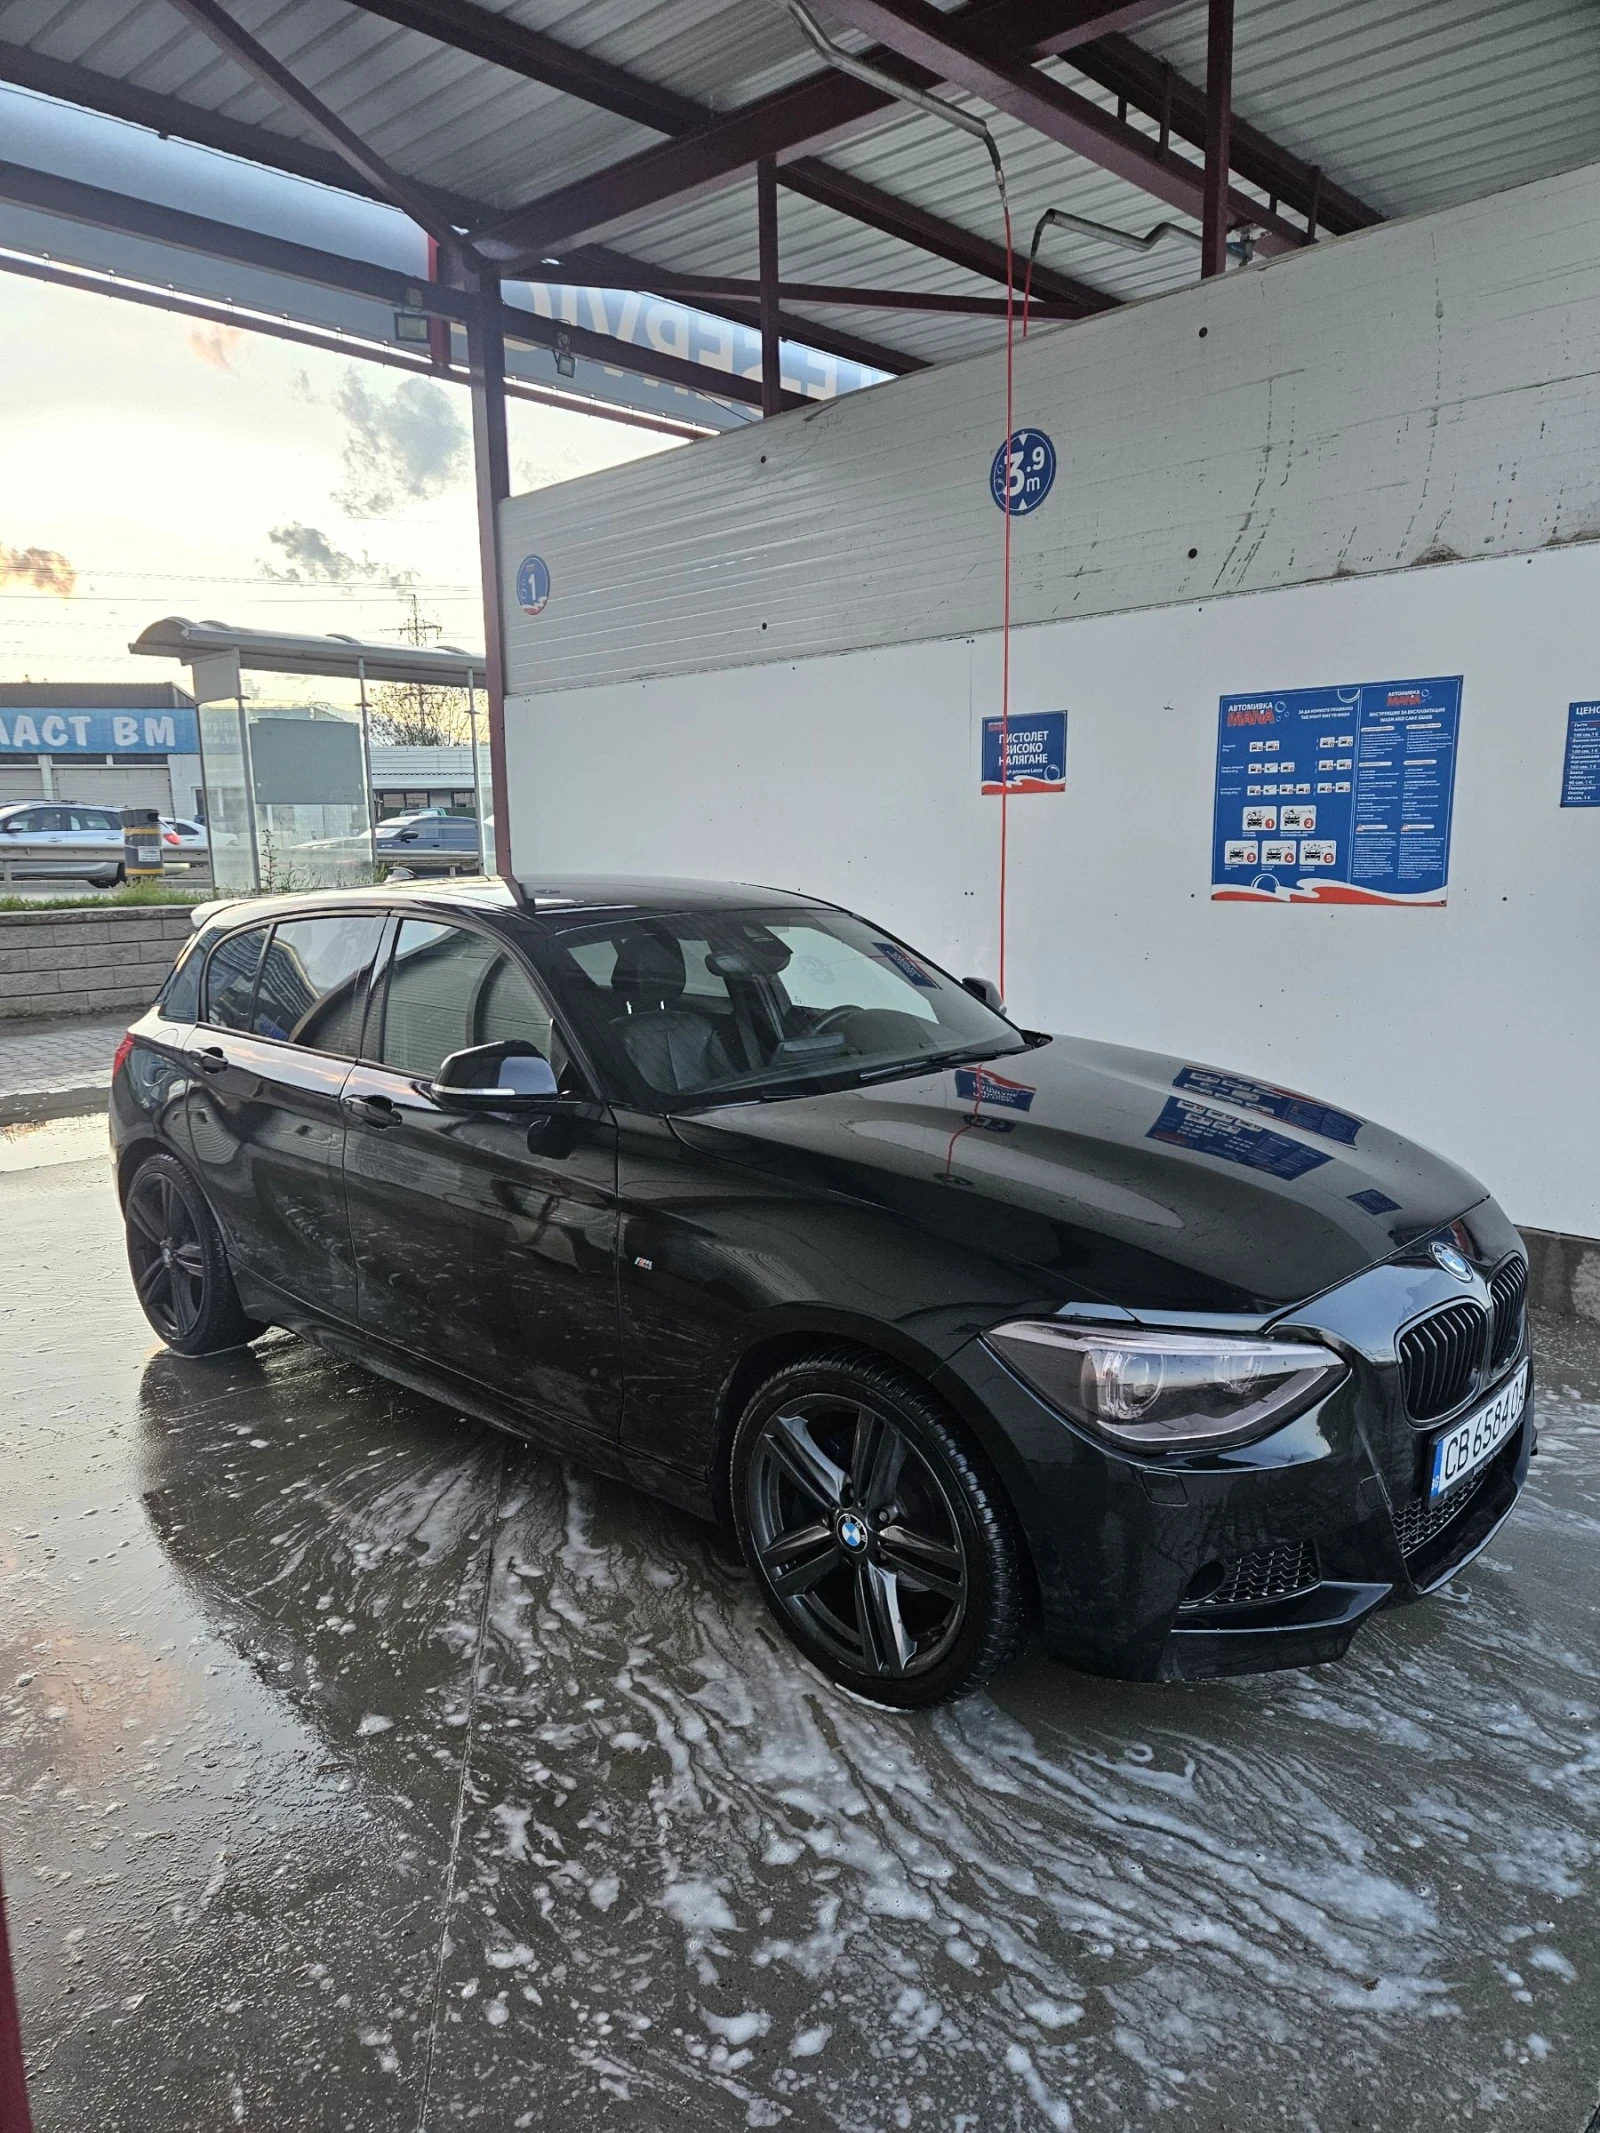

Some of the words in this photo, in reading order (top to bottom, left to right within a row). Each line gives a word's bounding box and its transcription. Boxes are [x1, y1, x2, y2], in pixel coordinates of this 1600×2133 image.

[1026, 476, 1040, 492] m
[528, 573, 537, 601] 1
[1228, 702, 1273, 712] АВТОМИВКА
[999, 730, 1049, 743] ПИСТОЛЕТ
[998, 754, 1048, 766] НАЛЯГАНЕ
[1306, 819, 1312, 827] 2
[1249, 854, 1254, 862] 3
[1286, 854, 1292, 862] 4
[1326, 854, 1332, 862] 5
